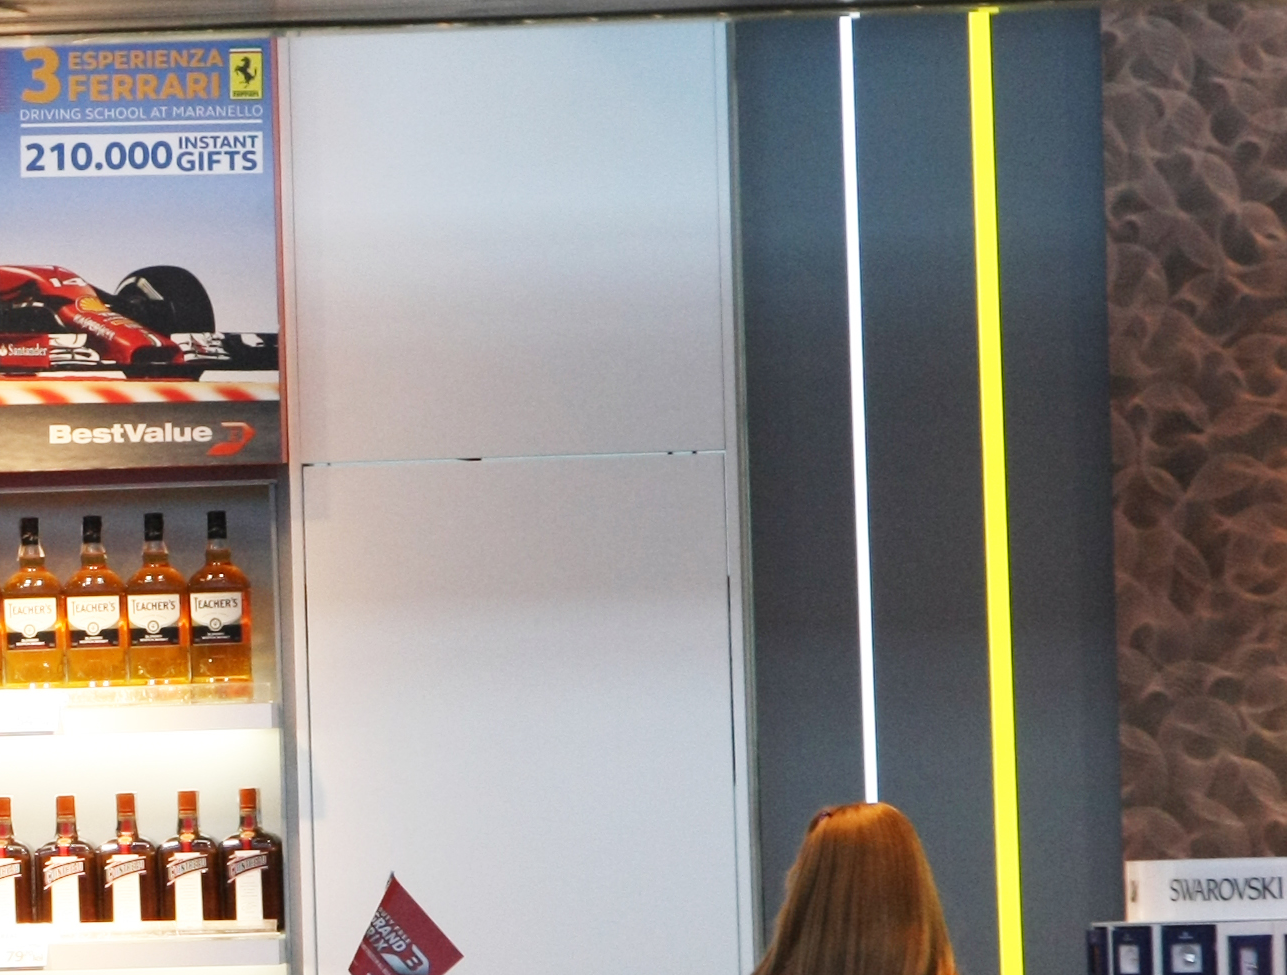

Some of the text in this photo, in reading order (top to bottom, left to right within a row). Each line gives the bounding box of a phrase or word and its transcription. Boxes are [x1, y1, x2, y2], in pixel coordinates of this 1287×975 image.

[67, 48, 224, 71] ESPERIENZA
[21, 46, 62, 104] 3
[67, 72, 221, 102] FERRARI
[20, 104, 264, 121] DRIVING SCHOOL AT MARANELLO
[178, 135, 259, 150] INSTANT
[25, 140, 173, 172] 210.000
[176, 150, 258, 172] GIFTS
[8, 343, 48, 357] Santander
[48, 422, 213, 444] BestValue
[1169, 876, 1284, 902] SWAROVSKI
